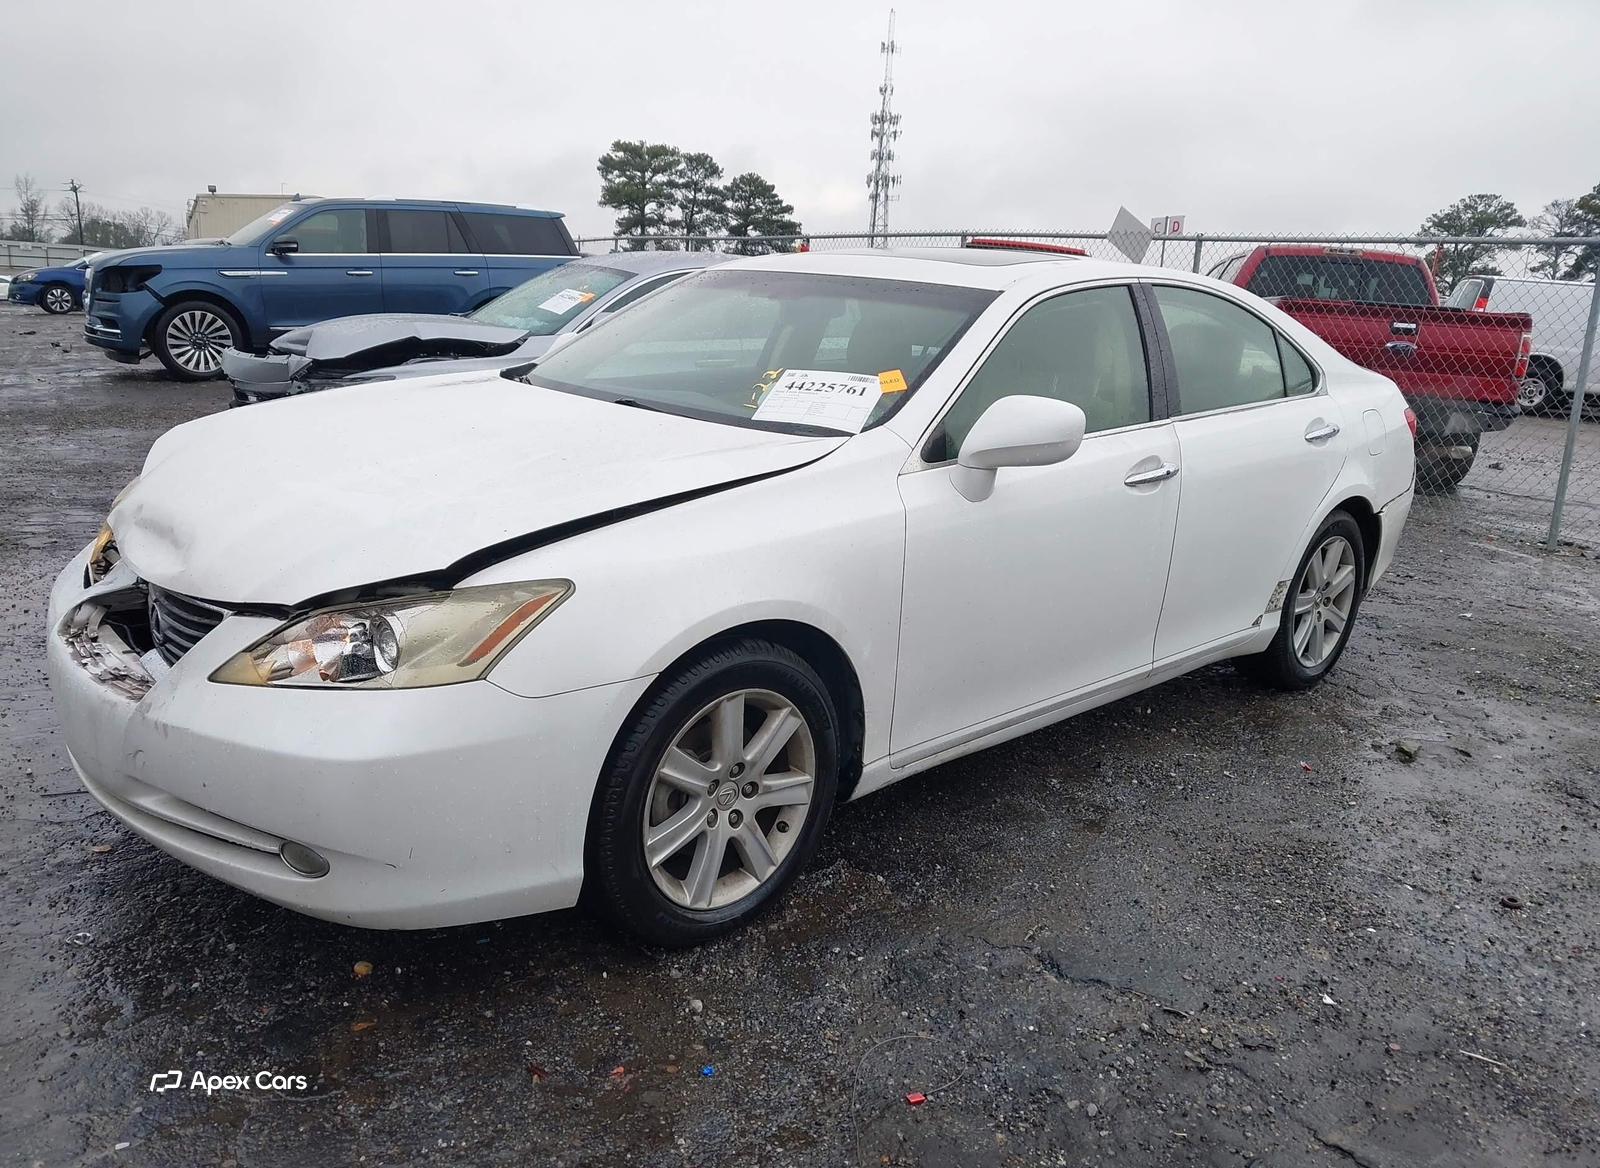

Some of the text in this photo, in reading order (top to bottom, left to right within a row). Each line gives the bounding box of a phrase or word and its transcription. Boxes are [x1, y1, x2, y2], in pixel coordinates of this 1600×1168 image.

[1154, 222, 1161, 234] C
[1172, 220, 1180, 233] D
[784, 380, 868, 397] 44225761
